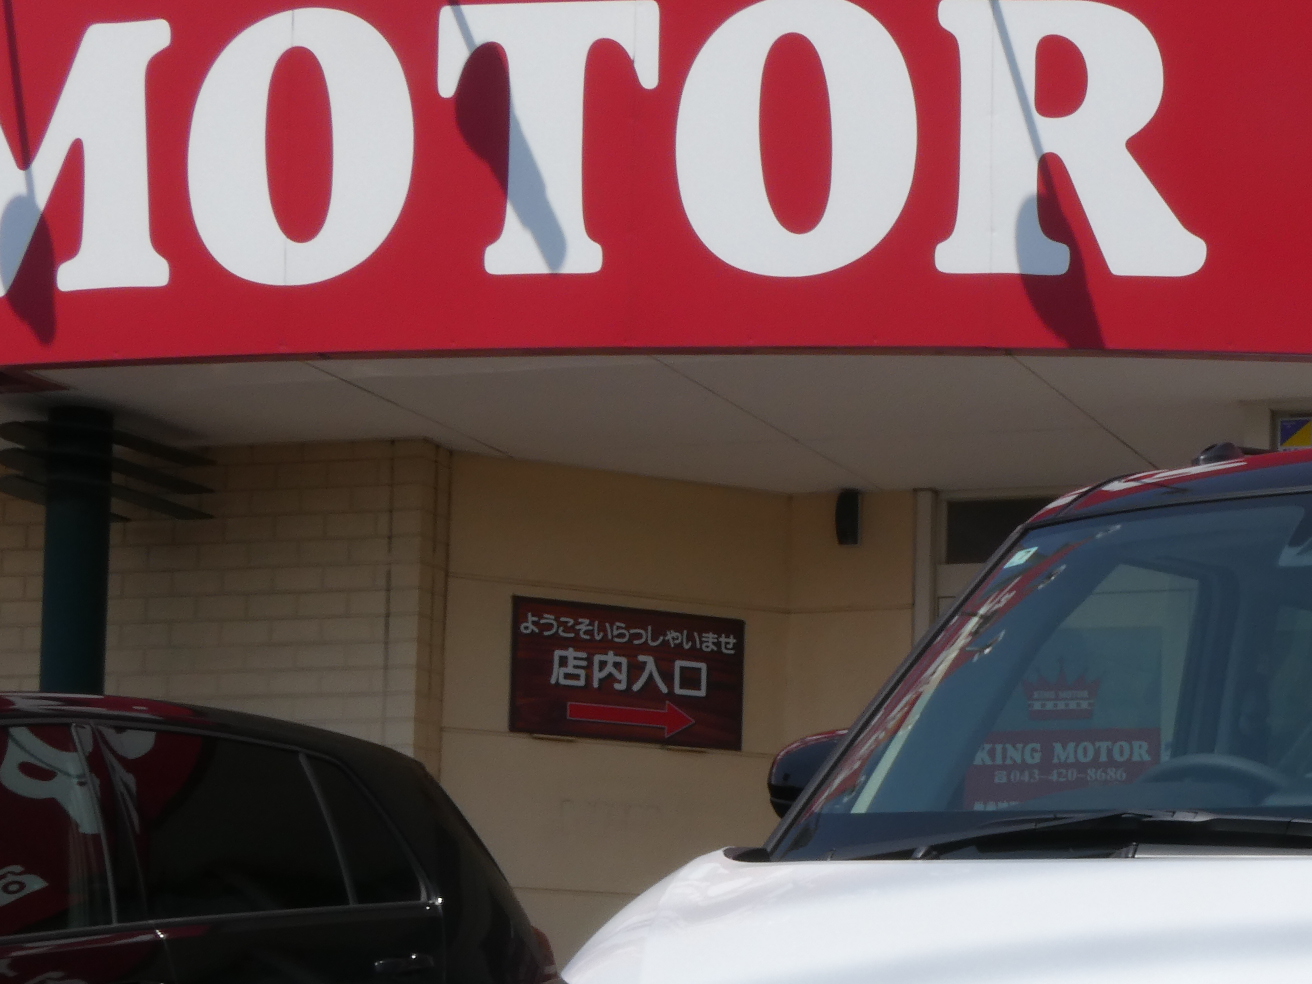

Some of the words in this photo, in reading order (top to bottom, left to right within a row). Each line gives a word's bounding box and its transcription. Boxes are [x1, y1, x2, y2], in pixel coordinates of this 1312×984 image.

[0, 0, 1207, 292] MOTOR
[519, 612, 737, 654] ようこそいらっしゃいませ
[550, 647, 707, 697] 店内入口
[973, 743, 1042, 766] KING
[1052, 741, 1151, 764] MOTOR
[1010, 767, 1127, 784] 043-420-8686
